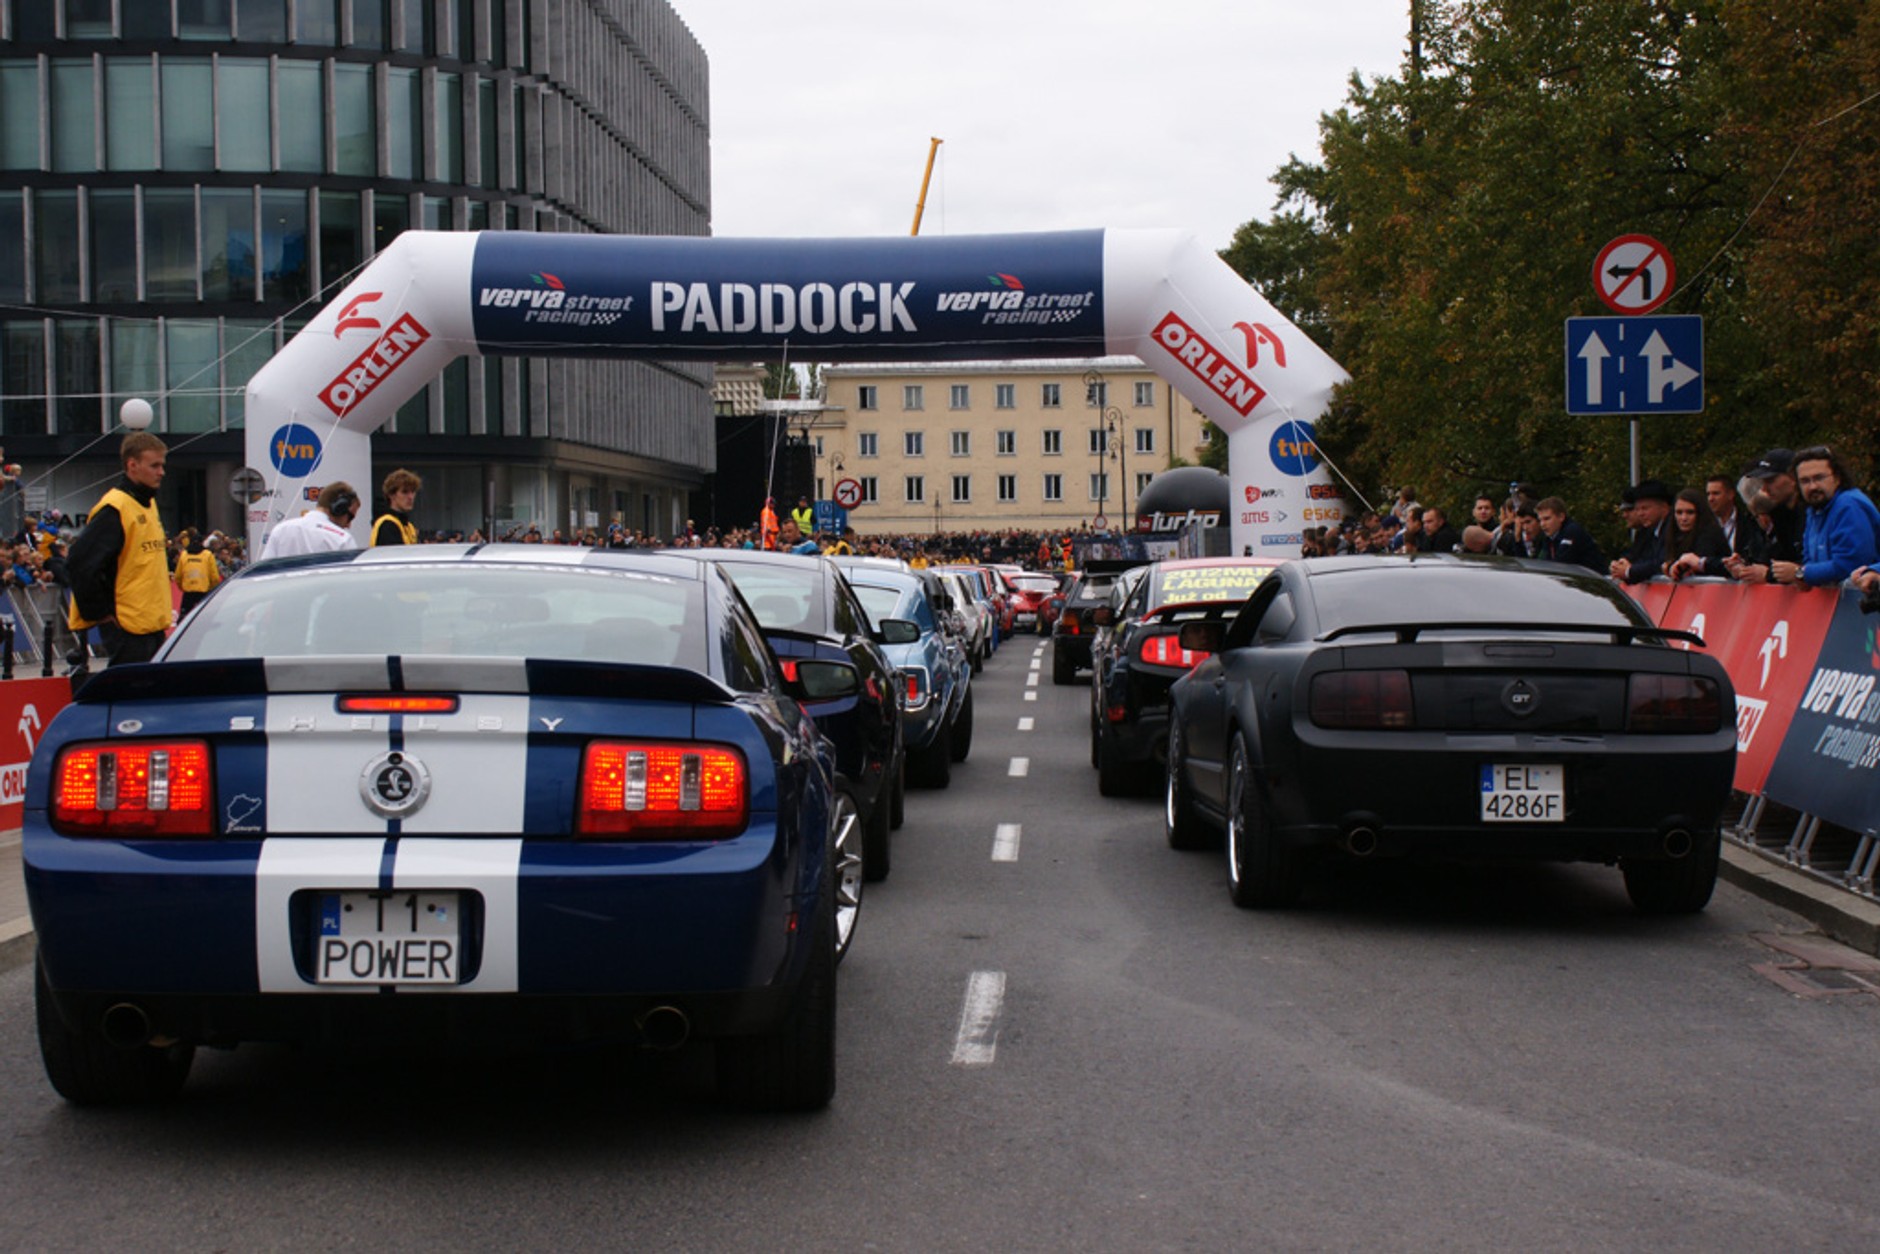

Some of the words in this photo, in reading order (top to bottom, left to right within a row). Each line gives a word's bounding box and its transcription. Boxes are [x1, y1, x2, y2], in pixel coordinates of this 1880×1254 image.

[480, 288, 565, 309] verva
[565, 295, 633, 311] street
[651, 281, 918, 333] PADDOCK
[936, 290, 1024, 311] verva
[1024, 291, 1095, 310] street
[525, 308, 593, 326] racing
[982, 307, 1052, 325] racing
[329, 321, 423, 408] ORLEN
[1160, 322, 1258, 409] ORLEN
[276, 439, 314, 459] tvn
[1276, 438, 1315, 457] tvn
[1147, 508, 1220, 532] turbo
[1241, 511, 1270, 524] ams
[1162, 577, 1260, 591] LAGUNA
[230, 715, 564, 731] SHELBY
[2, 769, 29, 799] ORL
[1505, 767, 1539, 791] EL
[1486, 794, 1559, 818] 4286F
[323, 917, 338, 929] PL
[324, 939, 453, 979] POWER
